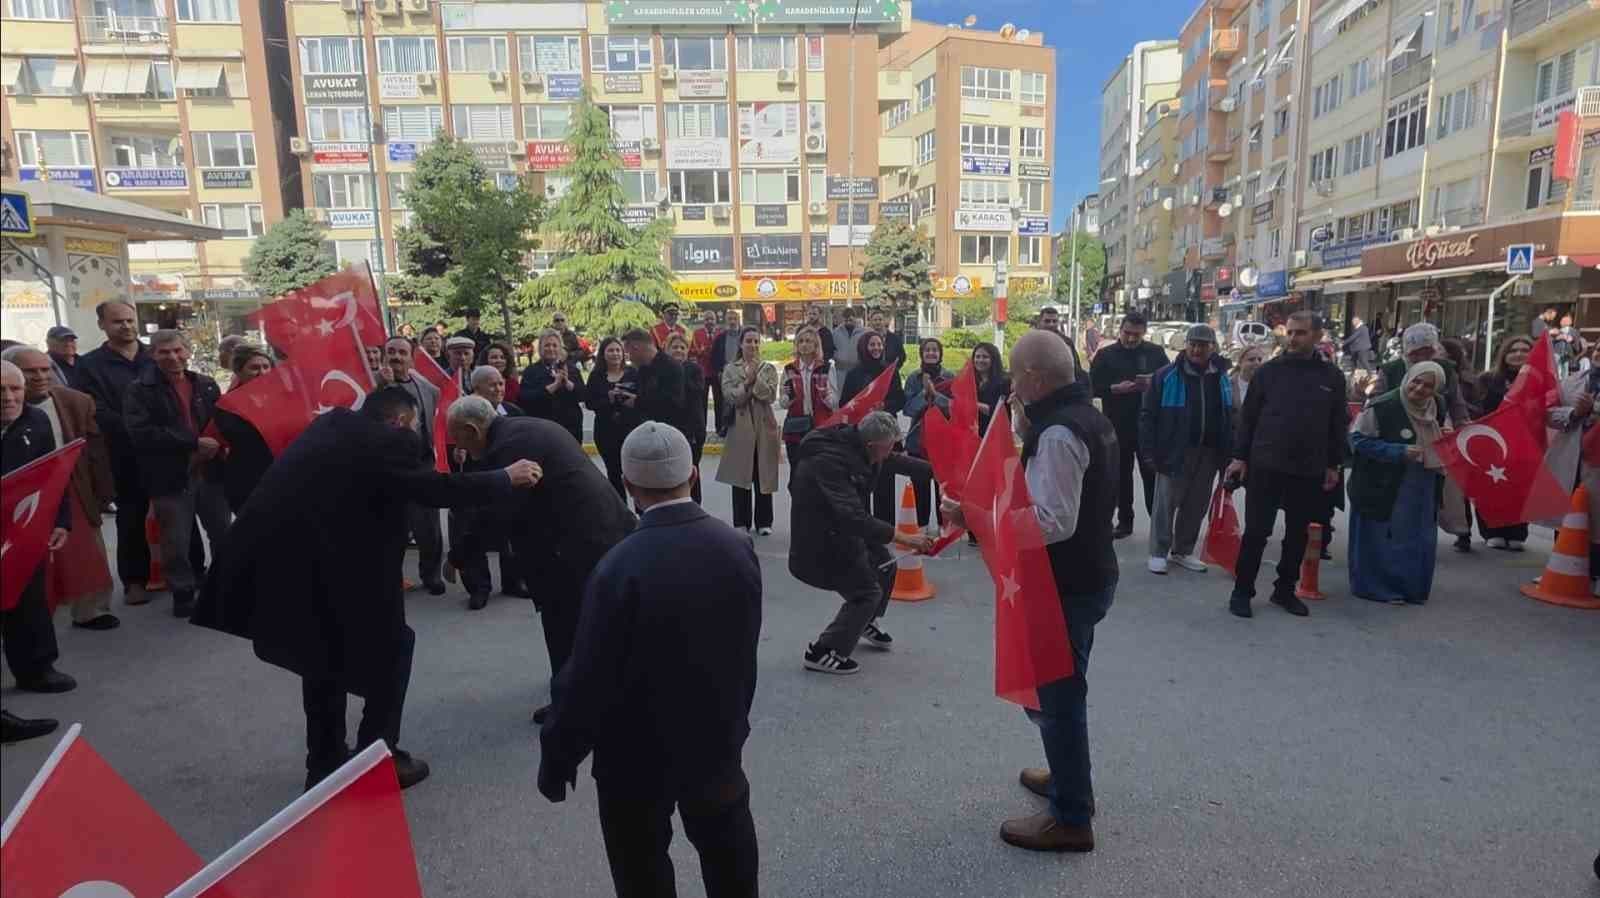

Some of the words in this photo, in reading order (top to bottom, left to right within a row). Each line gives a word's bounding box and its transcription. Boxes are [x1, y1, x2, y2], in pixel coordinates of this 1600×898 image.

[312, 78, 358, 89] AVUKAT
[534, 143, 571, 154] AVUKA
[332, 213, 371, 222] AVUKAT
